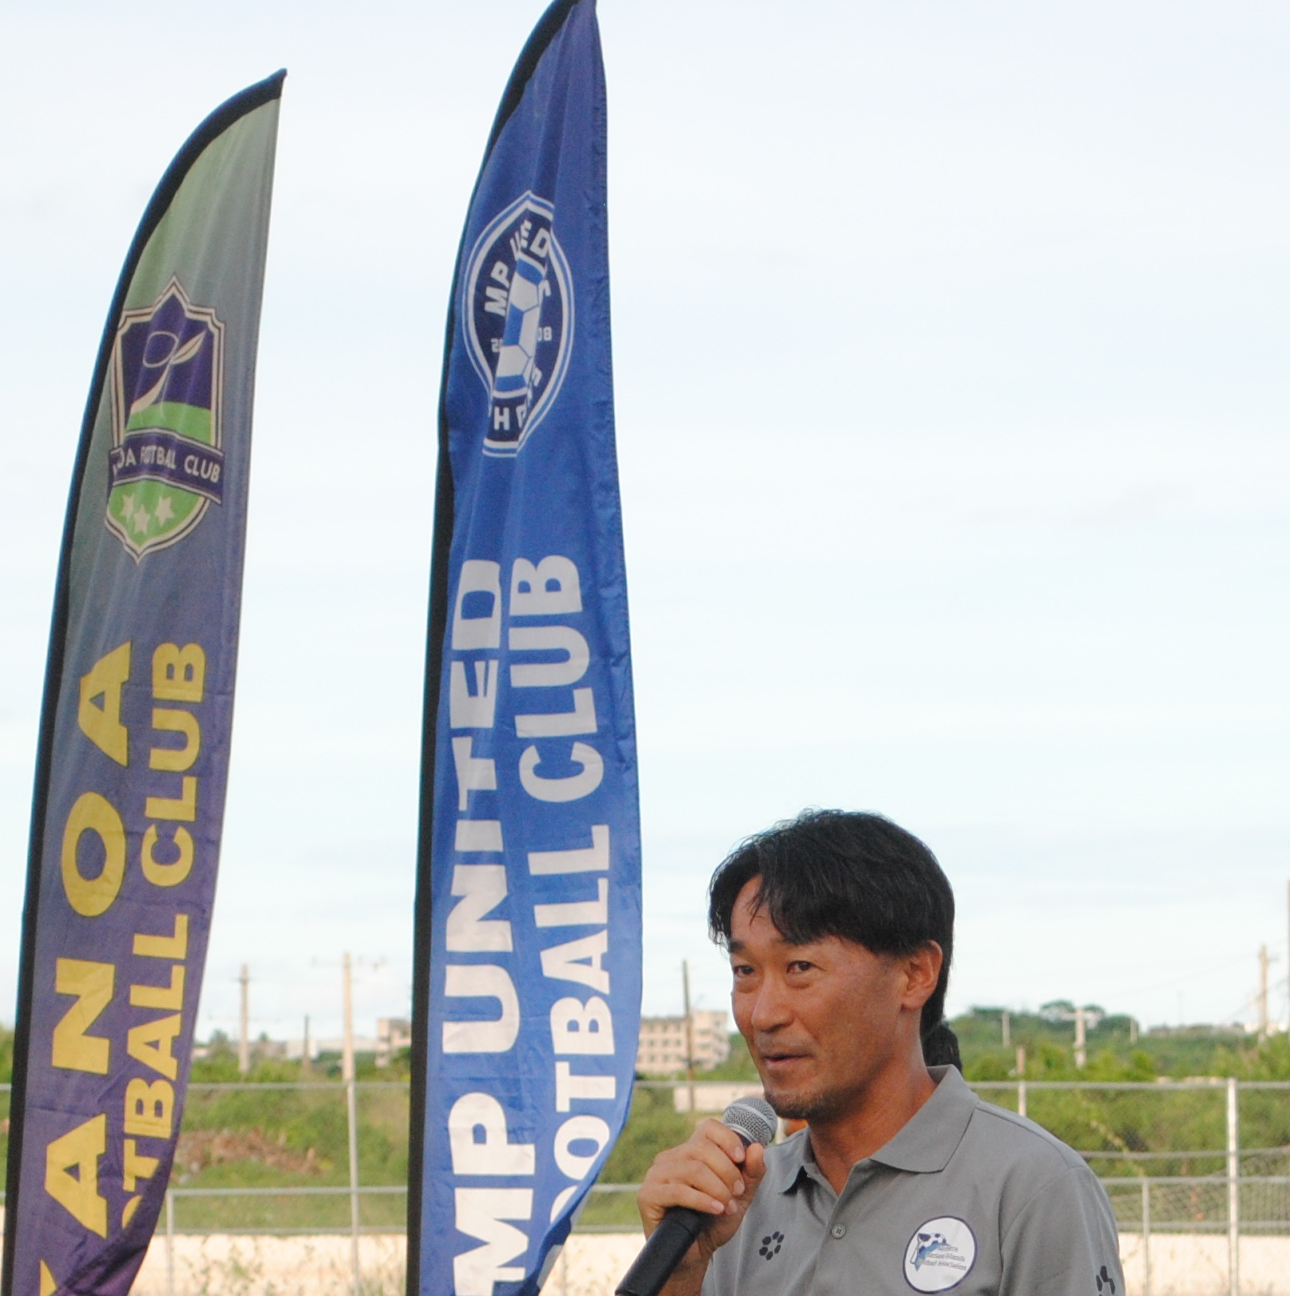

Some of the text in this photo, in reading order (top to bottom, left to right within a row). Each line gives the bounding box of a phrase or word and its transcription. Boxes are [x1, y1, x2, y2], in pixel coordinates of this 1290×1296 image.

[484, 260, 511, 317] MP
[183, 454, 221, 484] CLUB
[140, 642, 207, 887] CLUB
[509, 554, 605, 803] CLUB
[442, 559, 521, 1054] UNITED
